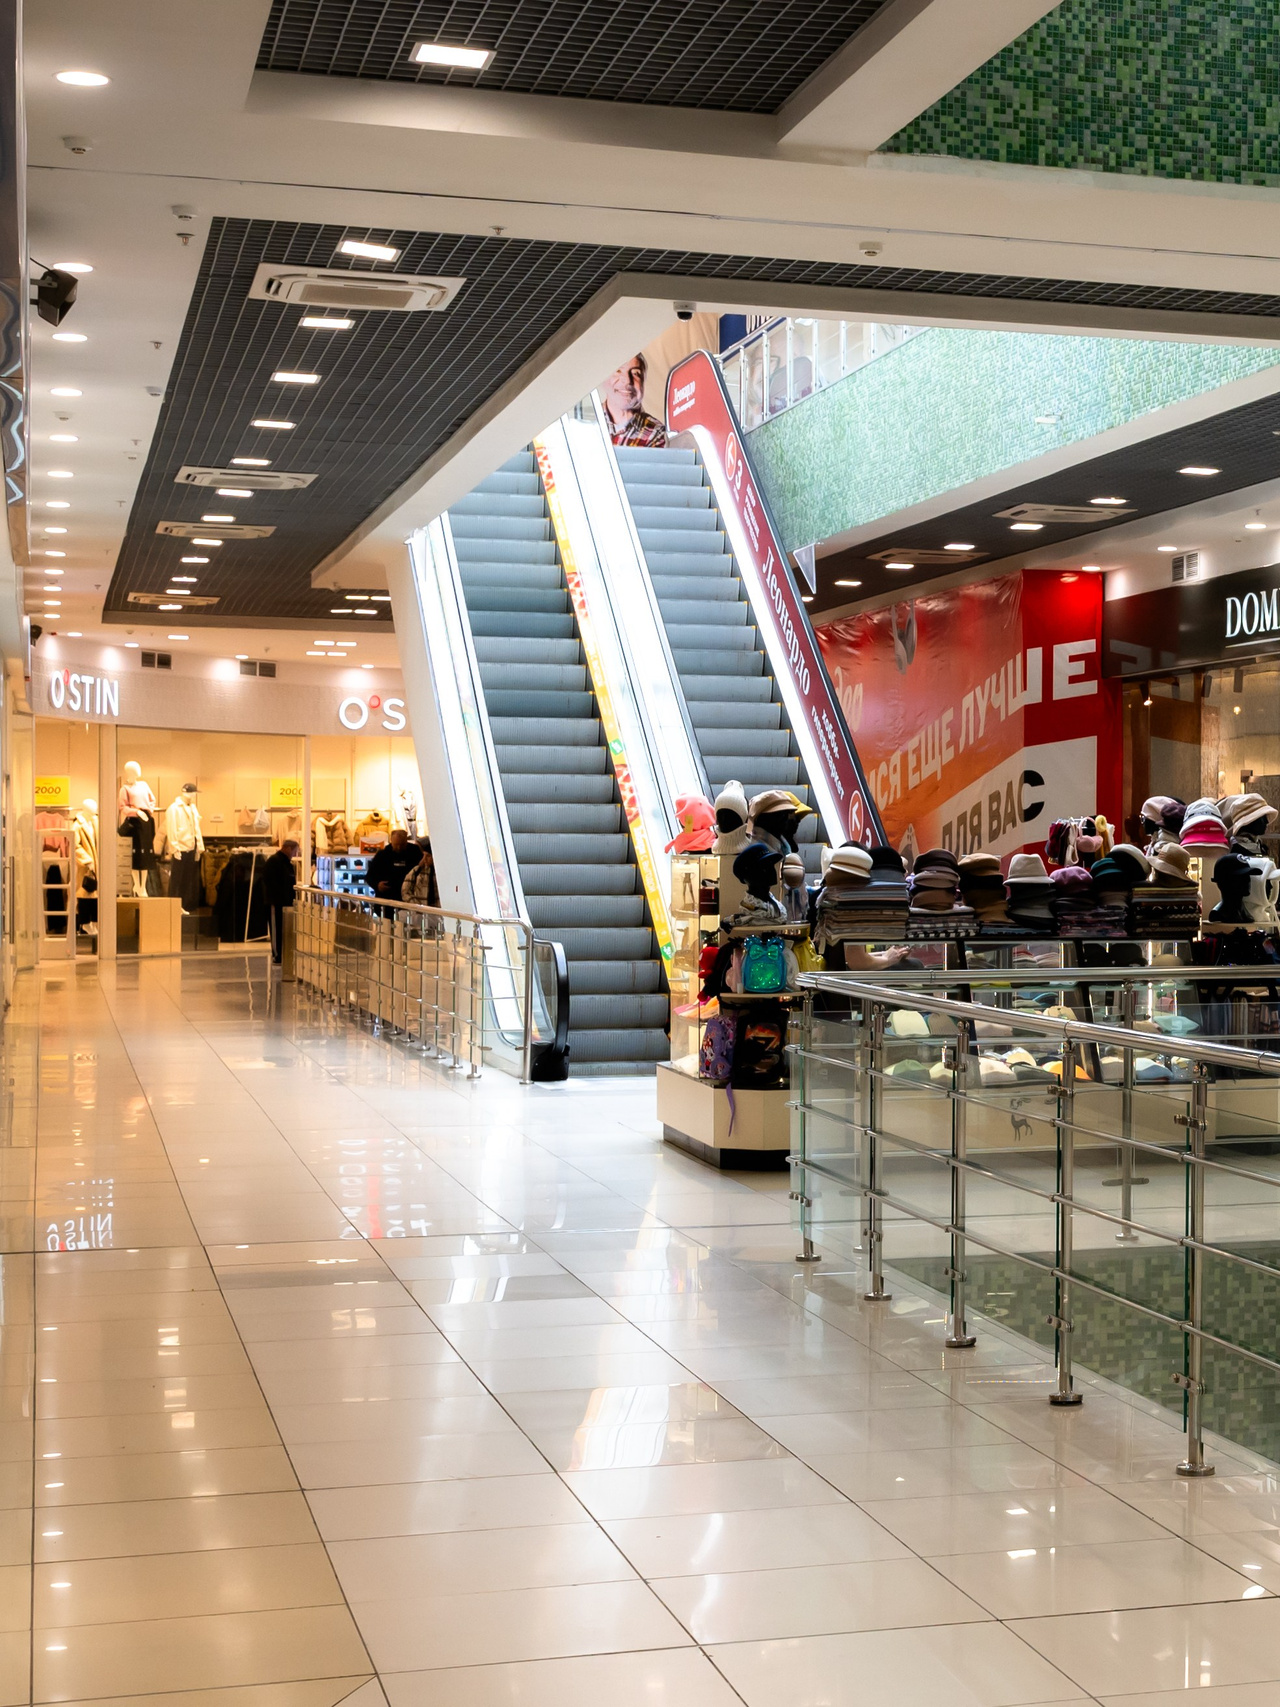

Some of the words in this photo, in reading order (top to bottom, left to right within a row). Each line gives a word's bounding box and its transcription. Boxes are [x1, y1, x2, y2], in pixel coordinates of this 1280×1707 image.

[762, 546, 811, 696] Леонардо
[51, 668, 119, 717] O'STIN
[338, 694, 407, 732] O'S
[907, 706, 955, 791] ЕЩЕ
[958, 638, 1099, 755] ЛУЧШЕ
[988, 769, 1046, 844] ВАС
